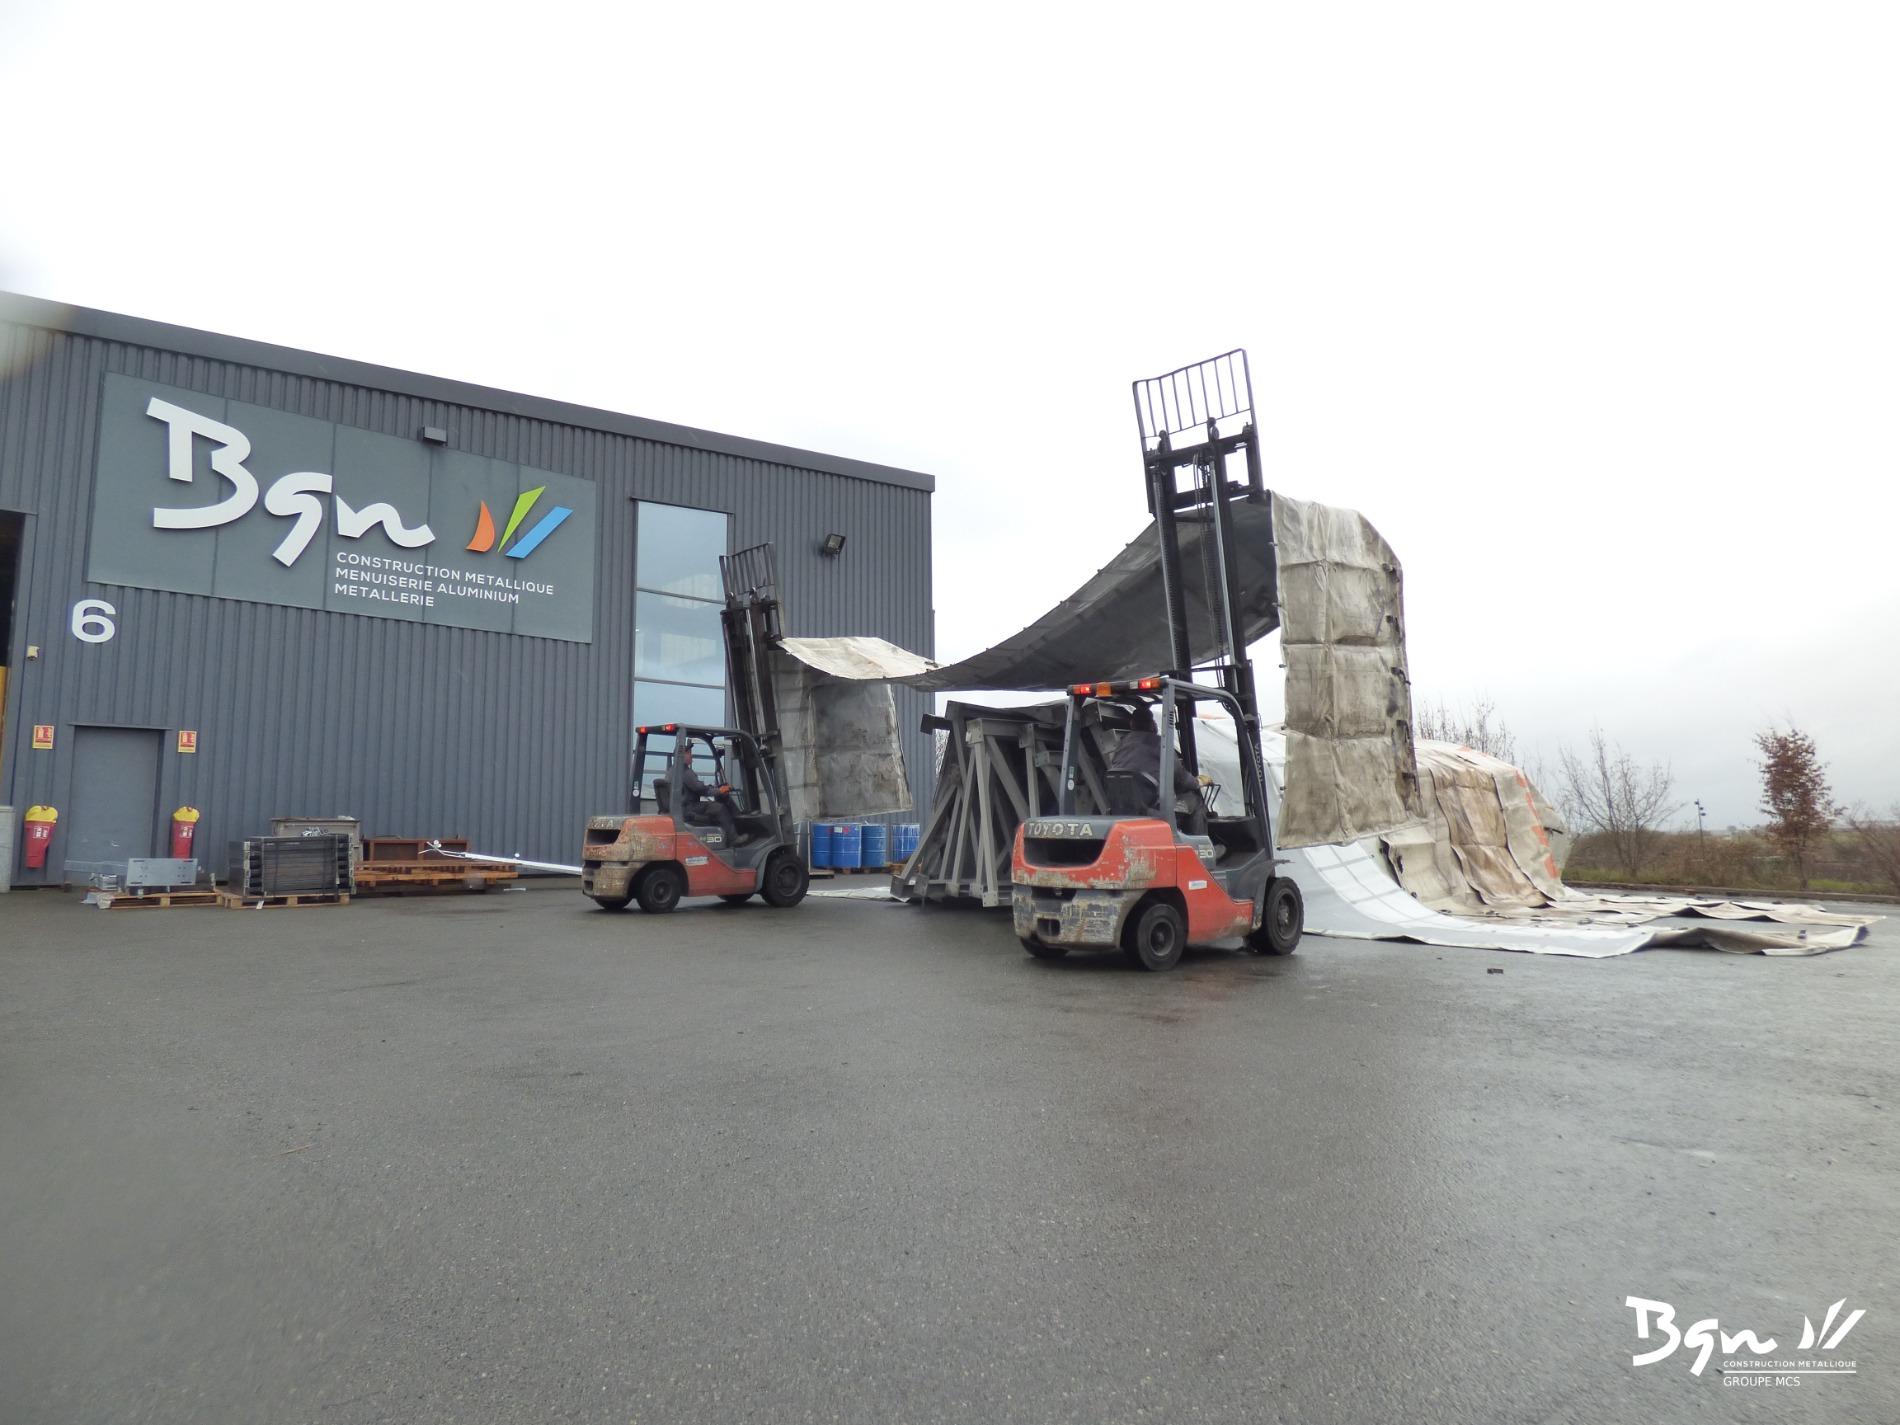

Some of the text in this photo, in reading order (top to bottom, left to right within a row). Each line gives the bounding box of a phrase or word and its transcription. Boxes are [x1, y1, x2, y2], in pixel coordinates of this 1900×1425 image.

[335, 567, 519, 604] MENUISERIE ALUMINIUM
[336, 552, 554, 595] CONSTRUCTION METALLIQUE
[334, 583, 434, 607] METALLERIE
[71, 599, 116, 643] 6
[1028, 823, 1093, 836] TOYOTA
